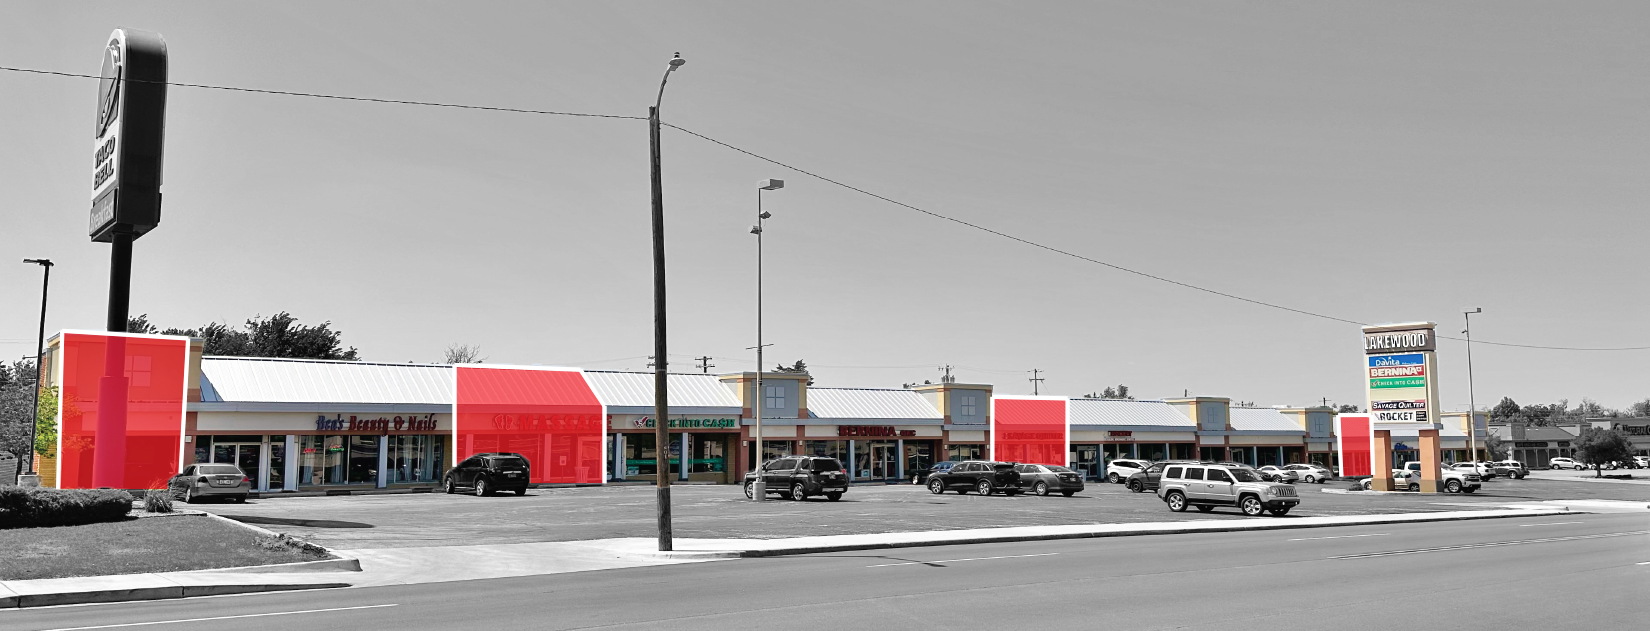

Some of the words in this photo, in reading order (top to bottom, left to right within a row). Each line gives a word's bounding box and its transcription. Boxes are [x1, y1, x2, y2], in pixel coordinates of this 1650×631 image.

[94, 135, 116, 169] TACO
[94, 158, 114, 190] BELL
[1364, 333, 1425, 350] LAKEWOOD
[1375, 356, 1400, 366] DaVita
[1370, 367, 1417, 376] BERNINA
[1379, 412, 1414, 421] ROCKET
[316, 413, 344, 431] Bea's
[348, 415, 389, 437] Beauty
[393, 415, 405, 430] &
[407, 413, 438, 431] Nails
[678, 418, 701, 428] INTO
[838, 425, 897, 437] BERNINA
